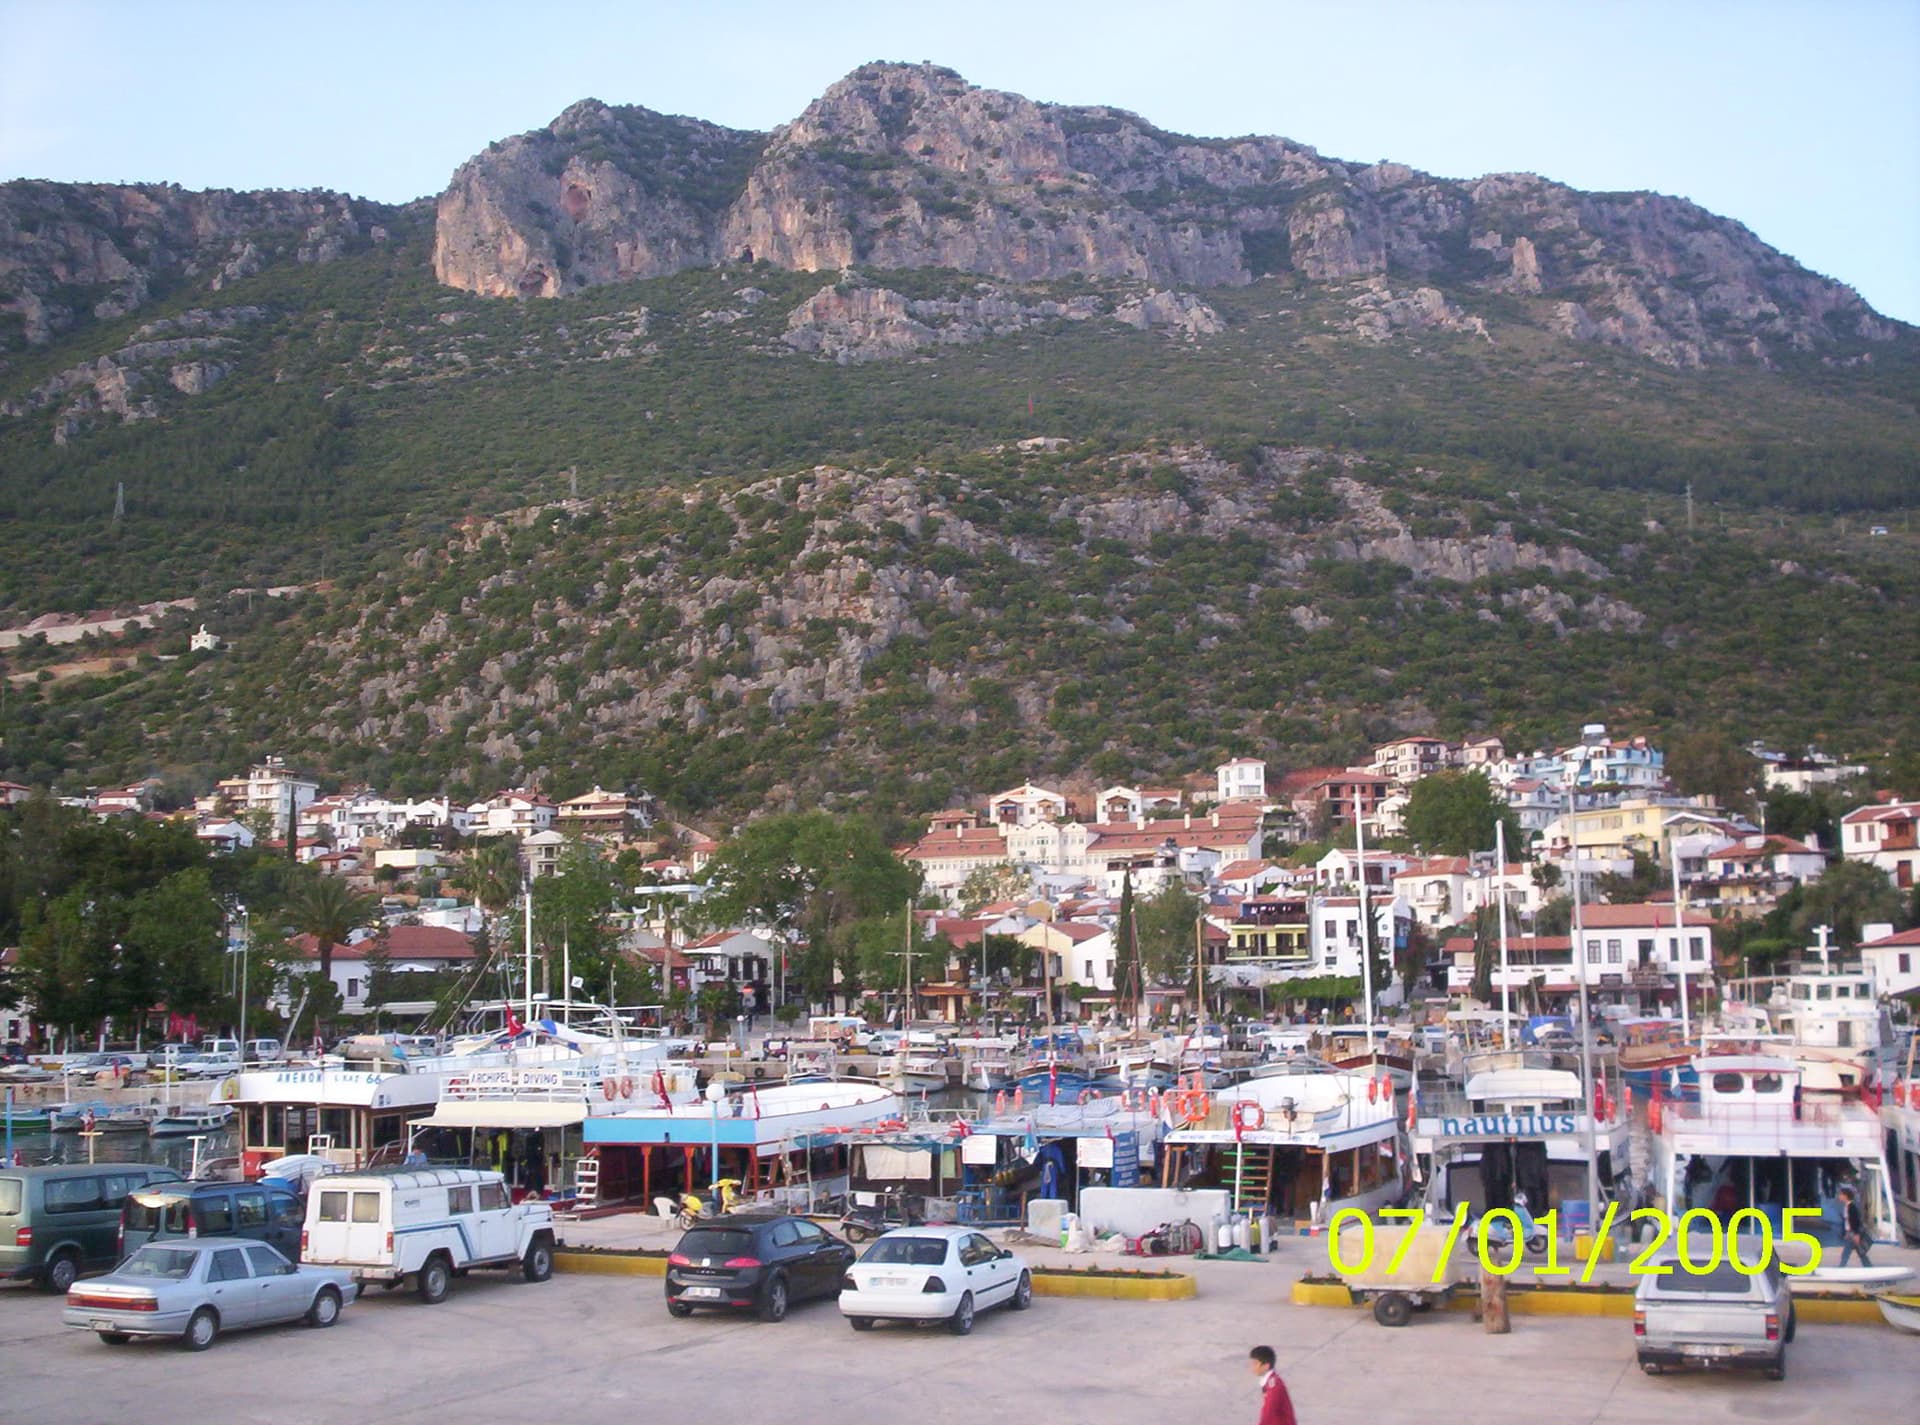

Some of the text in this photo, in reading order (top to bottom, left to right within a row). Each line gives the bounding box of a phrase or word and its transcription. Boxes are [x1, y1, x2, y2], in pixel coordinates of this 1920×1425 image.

[366, 1074, 382, 1085] 66
[469, 1072, 511, 1083] ARCHIPEL
[523, 1073, 558, 1085] DIVING
[1443, 1113, 1576, 1136] nautilus
